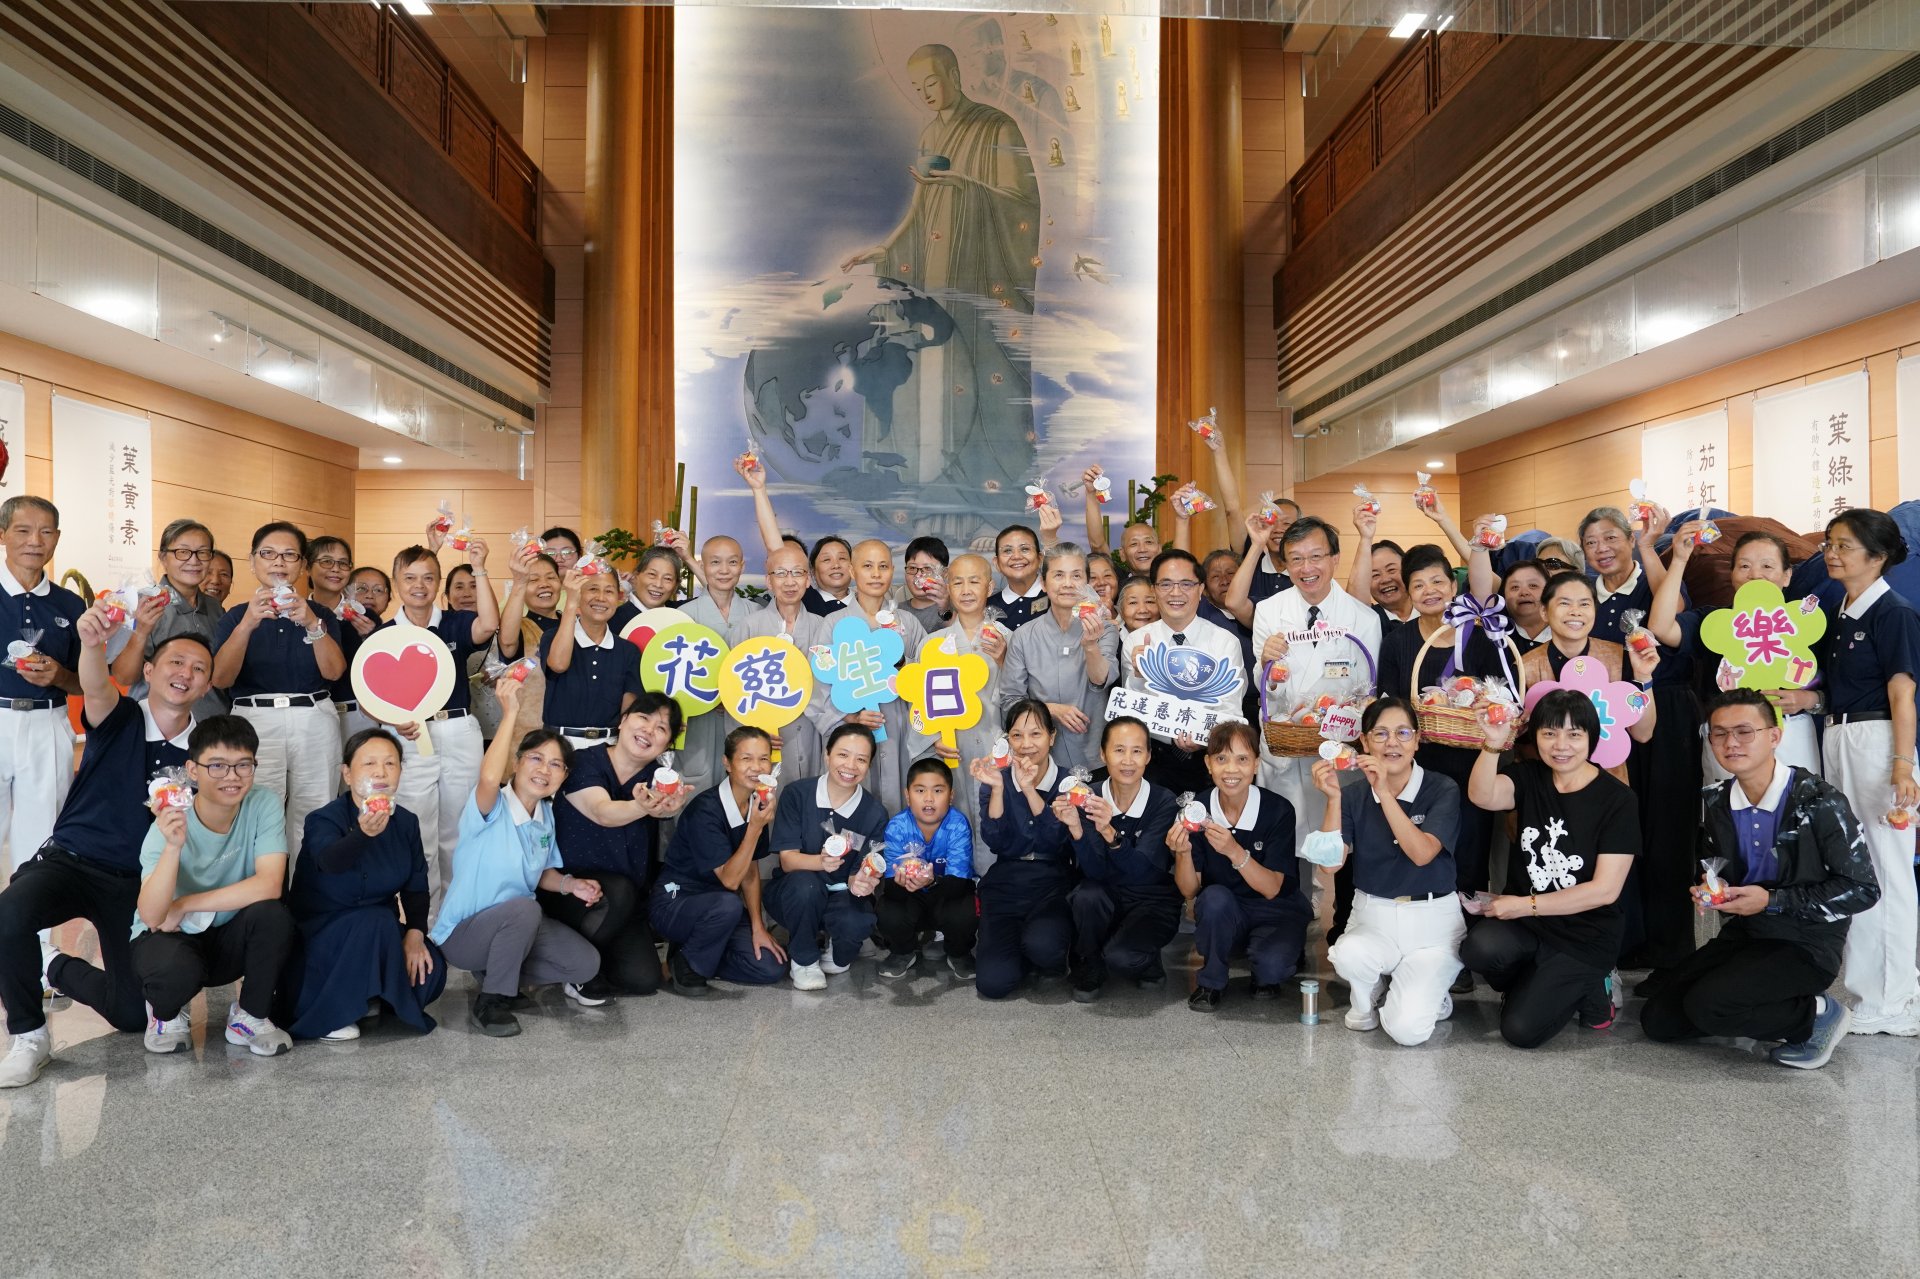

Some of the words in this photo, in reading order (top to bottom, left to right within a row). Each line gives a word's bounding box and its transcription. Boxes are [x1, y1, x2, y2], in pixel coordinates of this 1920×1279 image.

[120, 444, 140, 546] 葉黃素
[1287, 627, 1320, 642] thank
[1323, 629, 1343, 642] you
[1733, 609, 1794, 663] 樂
[658, 635, 719, 701] 花
[734, 649, 803, 714] 慈
[839, 640, 888, 698] 生
[926, 668, 965, 719] 日
[1112, 691, 1239, 732] 花蓮慈濟醫
[1151, 721, 1170, 733] Tzu
[1329, 714, 1357, 728] Happy
